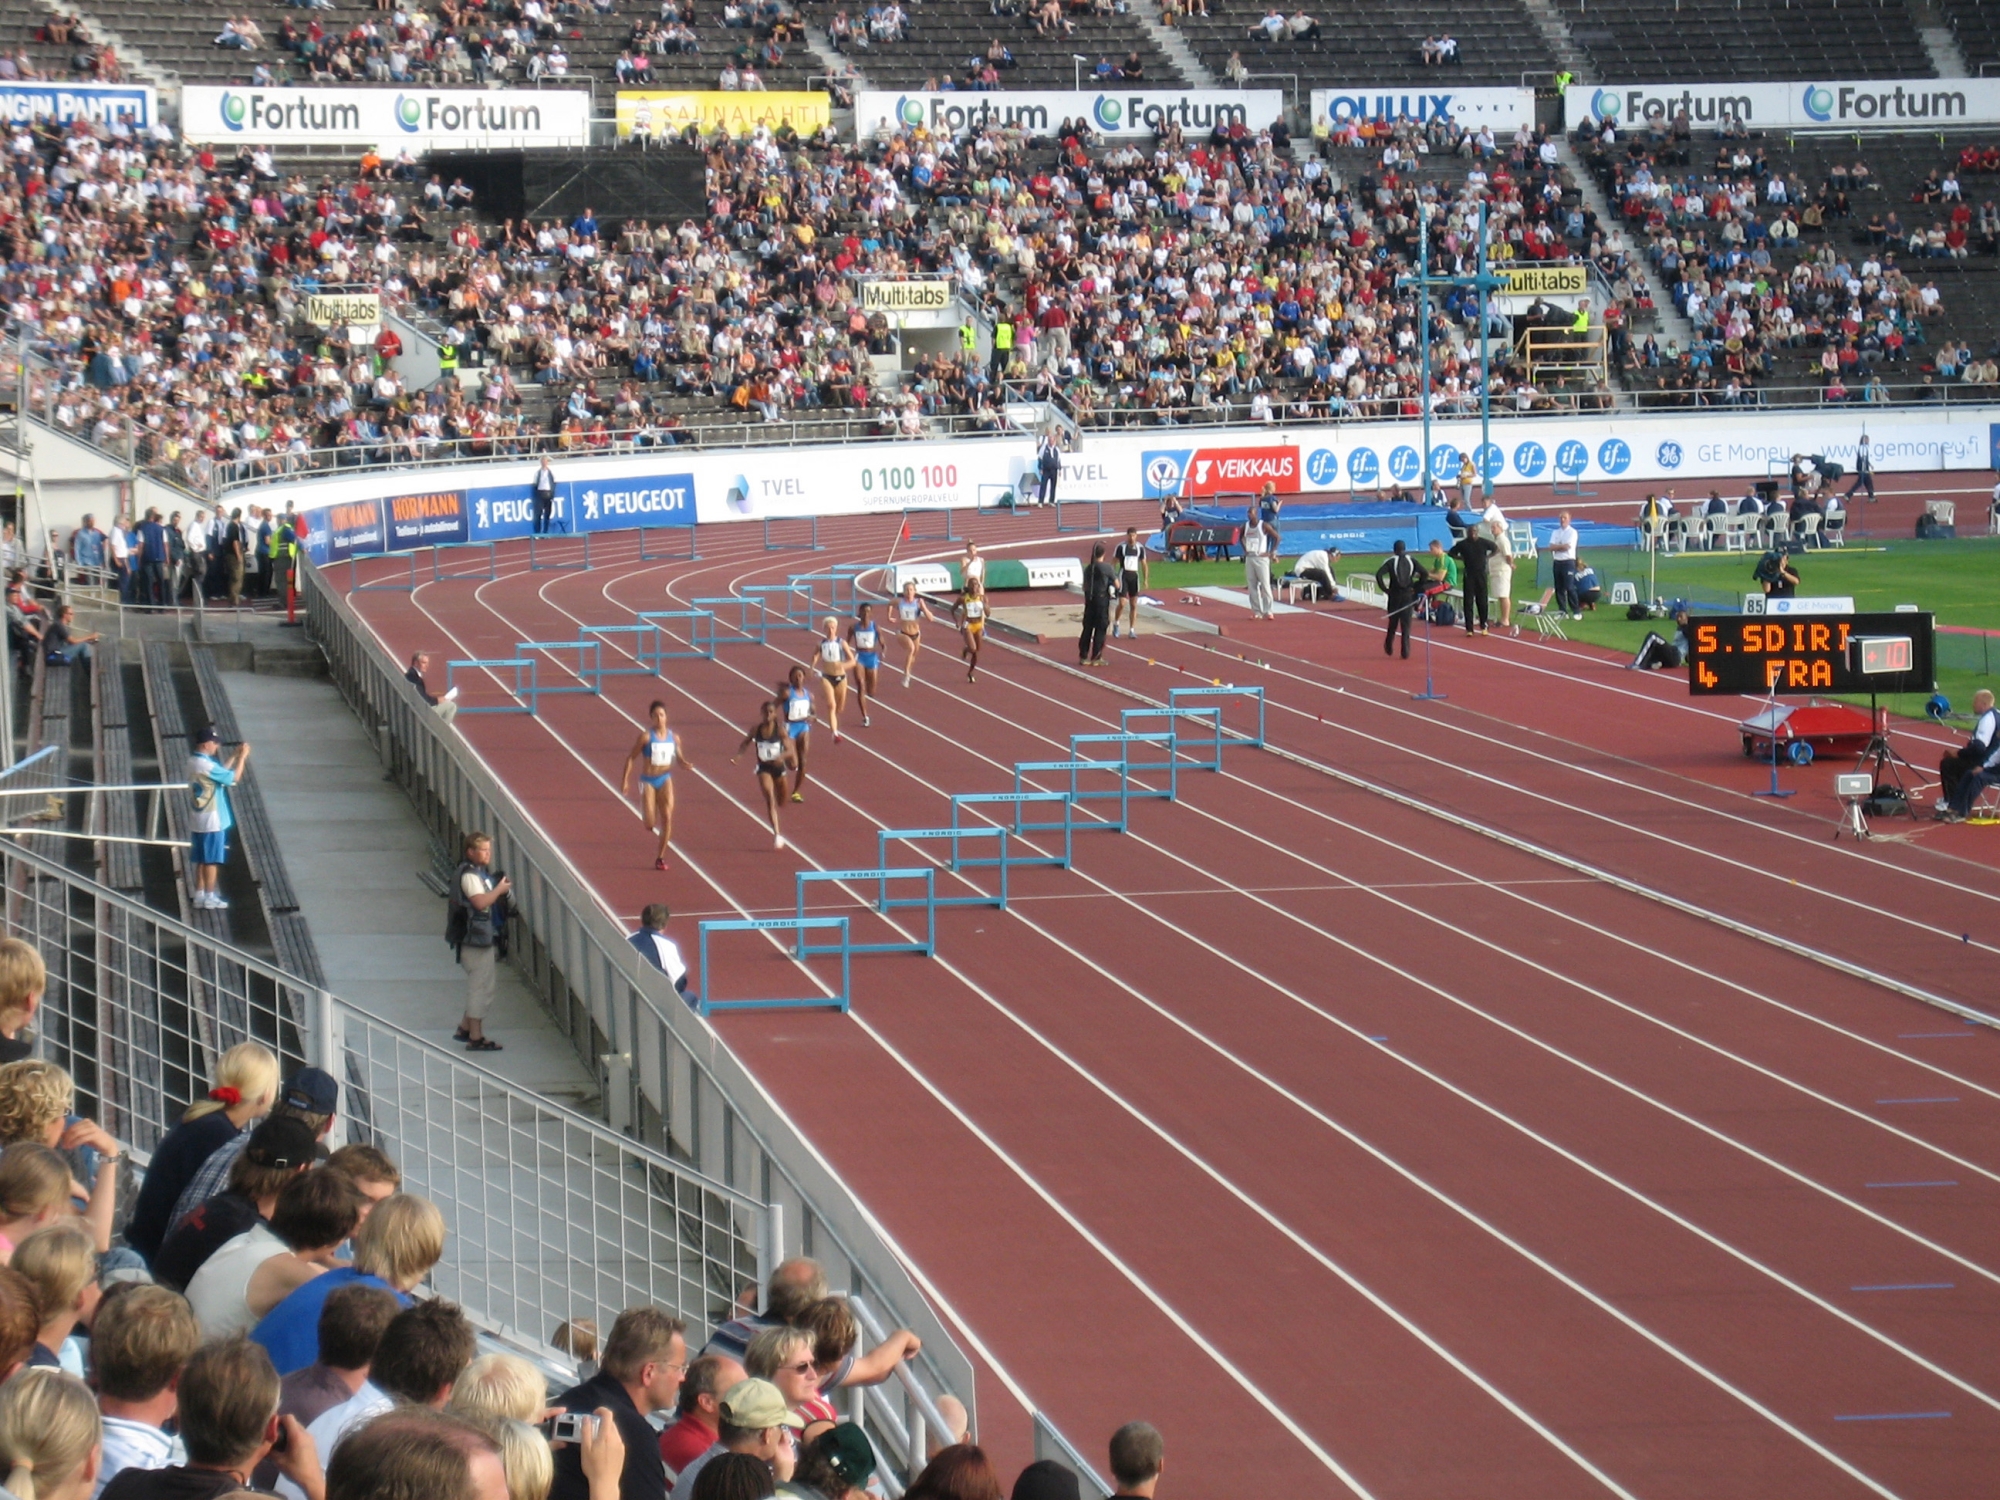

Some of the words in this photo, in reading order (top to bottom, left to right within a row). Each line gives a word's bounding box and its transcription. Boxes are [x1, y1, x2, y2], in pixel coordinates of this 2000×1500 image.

[251, 95, 359, 130] Fortum
[426, 97, 541, 131] Fortum
[663, 105, 819, 123] SAUNALAHTI
[930, 98, 1047, 129] Fortum
[1128, 97, 1246, 128] Fortum
[1627, 90, 1752, 122] Fortum
[1838, 86, 1966, 118] Fortum
[1698, 444, 1722, 462] GE
[1728, 443, 1790, 462] Money
[862, 468, 873, 491] 0
[879, 466, 915, 490] 100
[921, 464, 957, 488] 100
[1062, 464, 1108, 481] TVEL
[1217, 457, 1293, 478] VEIKKAUS
[761, 478, 805, 496] TVEL
[492, 497, 565, 524] PEUGOT
[603, 488, 686, 515] PEUGEOT
[1031, 569, 1071, 579] Level
[1615, 589, 1631, 602] 90
[1747, 600, 1763, 613] 85
[1699, 661, 1718, 688] 4
[1766, 660, 1832, 687] FRA
